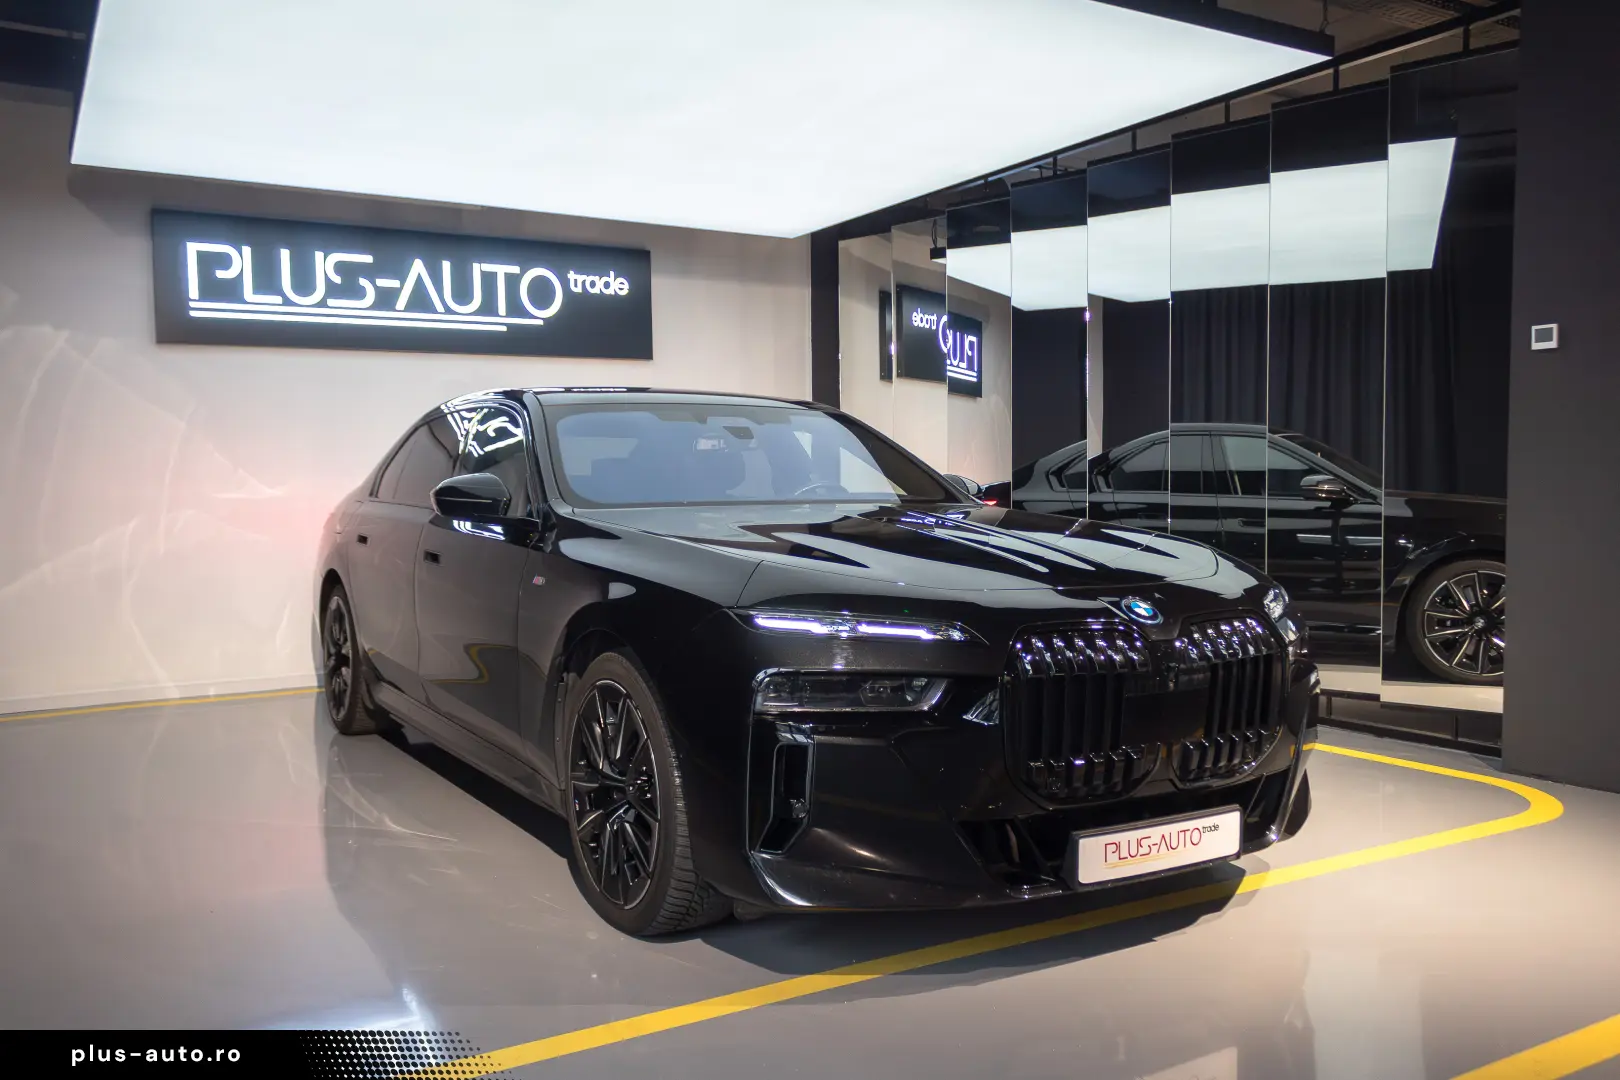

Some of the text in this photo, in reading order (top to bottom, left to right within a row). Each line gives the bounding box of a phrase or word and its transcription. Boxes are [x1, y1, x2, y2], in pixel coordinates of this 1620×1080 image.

[186, 241, 630, 318] PLUS-AUTO trade
[1104, 823, 1219, 863] PLUS-AUTO trade
